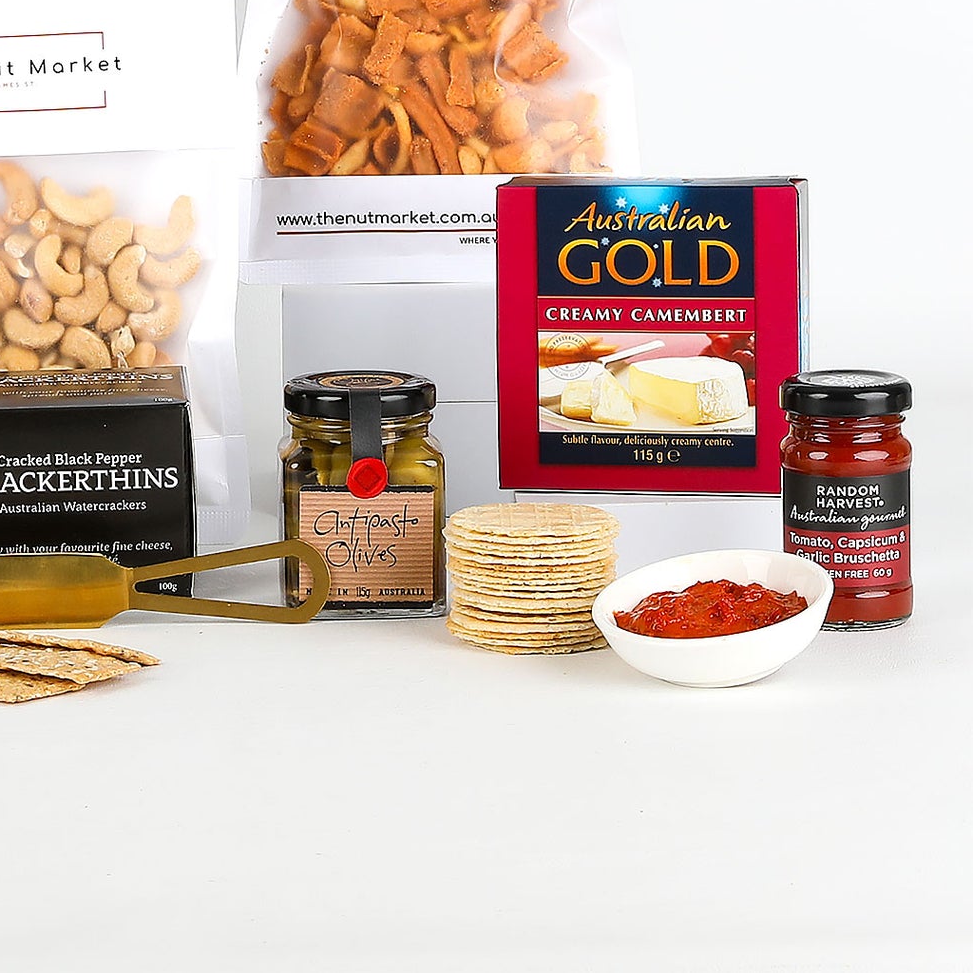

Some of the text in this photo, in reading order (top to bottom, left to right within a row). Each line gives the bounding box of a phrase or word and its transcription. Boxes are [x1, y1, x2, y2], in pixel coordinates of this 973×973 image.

[29, 56, 122, 75] Market
[564, 201, 731, 232] Australian
[459, 237, 490, 245] WHERE
[557, 238, 741, 287] GOLD
[545, 307, 747, 323] CREAMY CAMEMBERT
[562, 435, 735, 448] Subtle flavour, deliciously creamy centre.
[54, 452, 92, 465] Black
[95, 452, 143, 468] Pepper
[633, 449, 654, 461] 115
[656, 451, 664, 463] g
[816, 485, 880, 496] RANDOM
[0, 499, 147, 514] Australian Watercrackers
[790, 504, 907, 530] Australian gourmet
[313, 504, 419, 547] Antipasto
[5, 543, 30, 554] with
[32, 544, 59, 554] your
[59, 542, 110, 554] favourite
[111, 541, 133, 553] fine
[135, 540, 173, 552] cheese,
[789, 530, 907, 550] Tomato, Capsicum &
[326, 537, 398, 573] Olives
[796, 549, 900, 564] Garlic Bruschetta
[844, 569, 870, 579] FREE
[873, 568, 886, 578] 60
[159, 581, 178, 592] 100g
[337, 588, 349, 596] IN
[378, 588, 426, 596] AUSTRALIA
